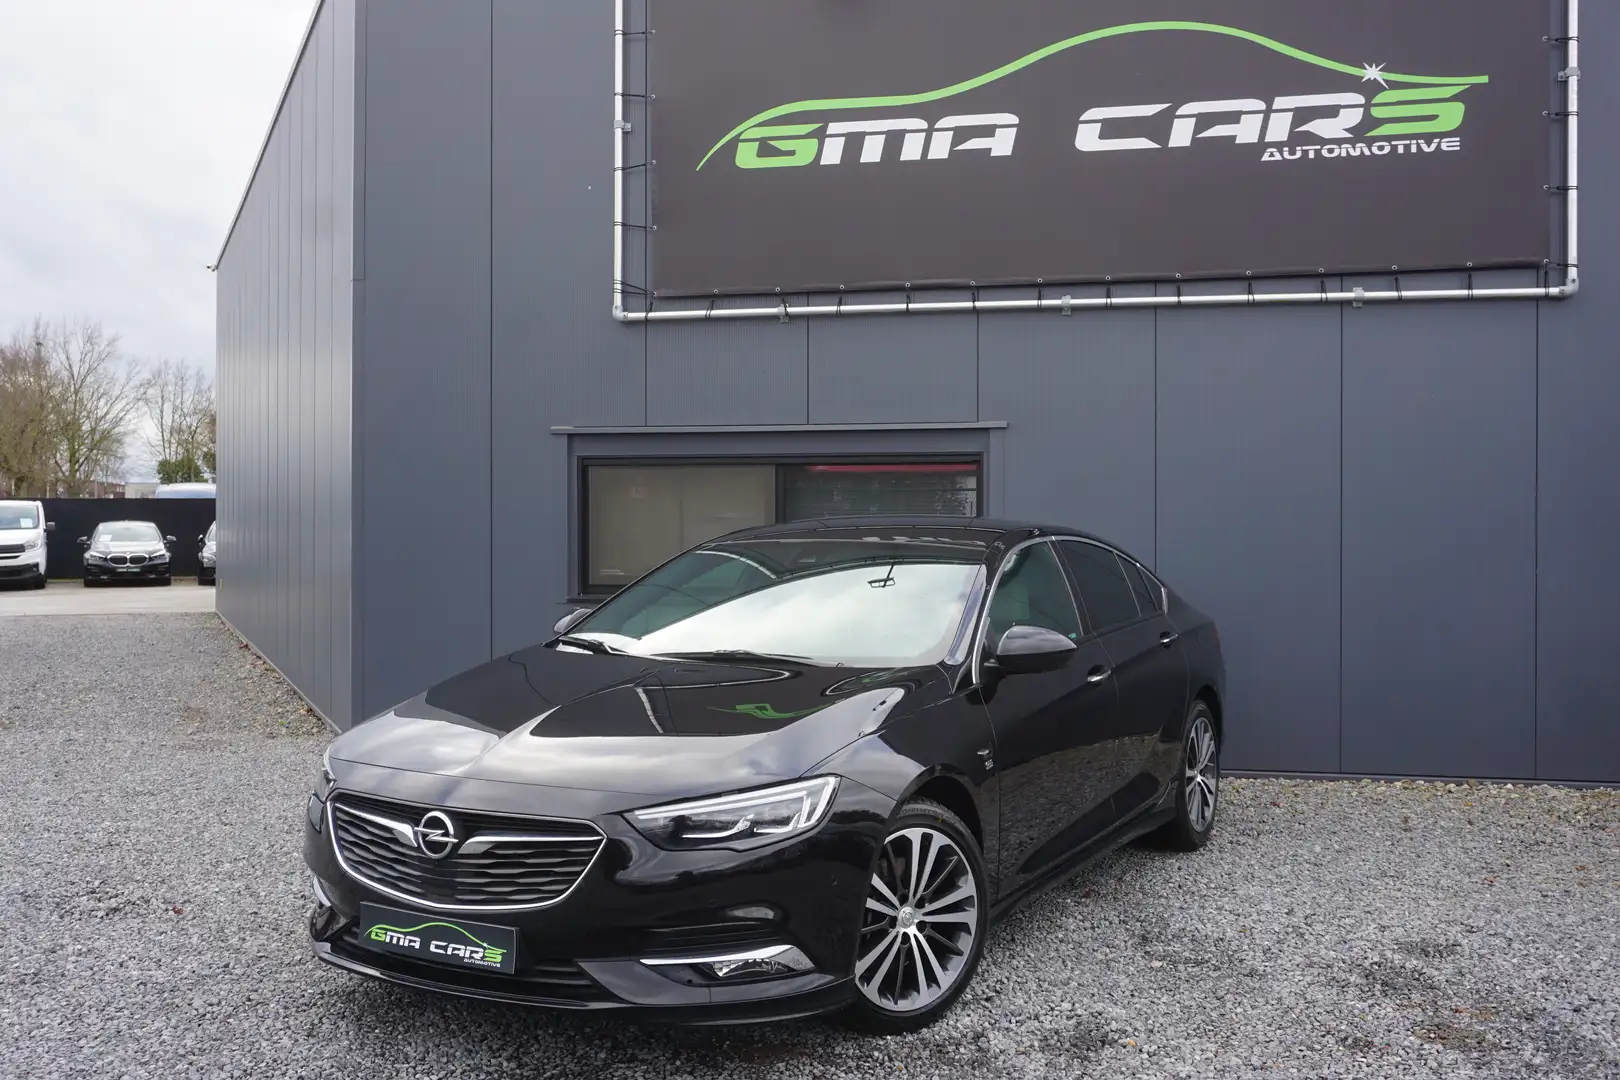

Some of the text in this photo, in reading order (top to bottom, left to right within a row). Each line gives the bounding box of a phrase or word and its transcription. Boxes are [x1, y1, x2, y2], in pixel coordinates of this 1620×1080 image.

[734, 85, 1472, 169] GMA CARS
[1260, 136, 1461, 162] AUTOMOTIVE
[370, 928, 504, 963] GMA CARS
[463, 957, 501, 968] AUTOMOTIVE
